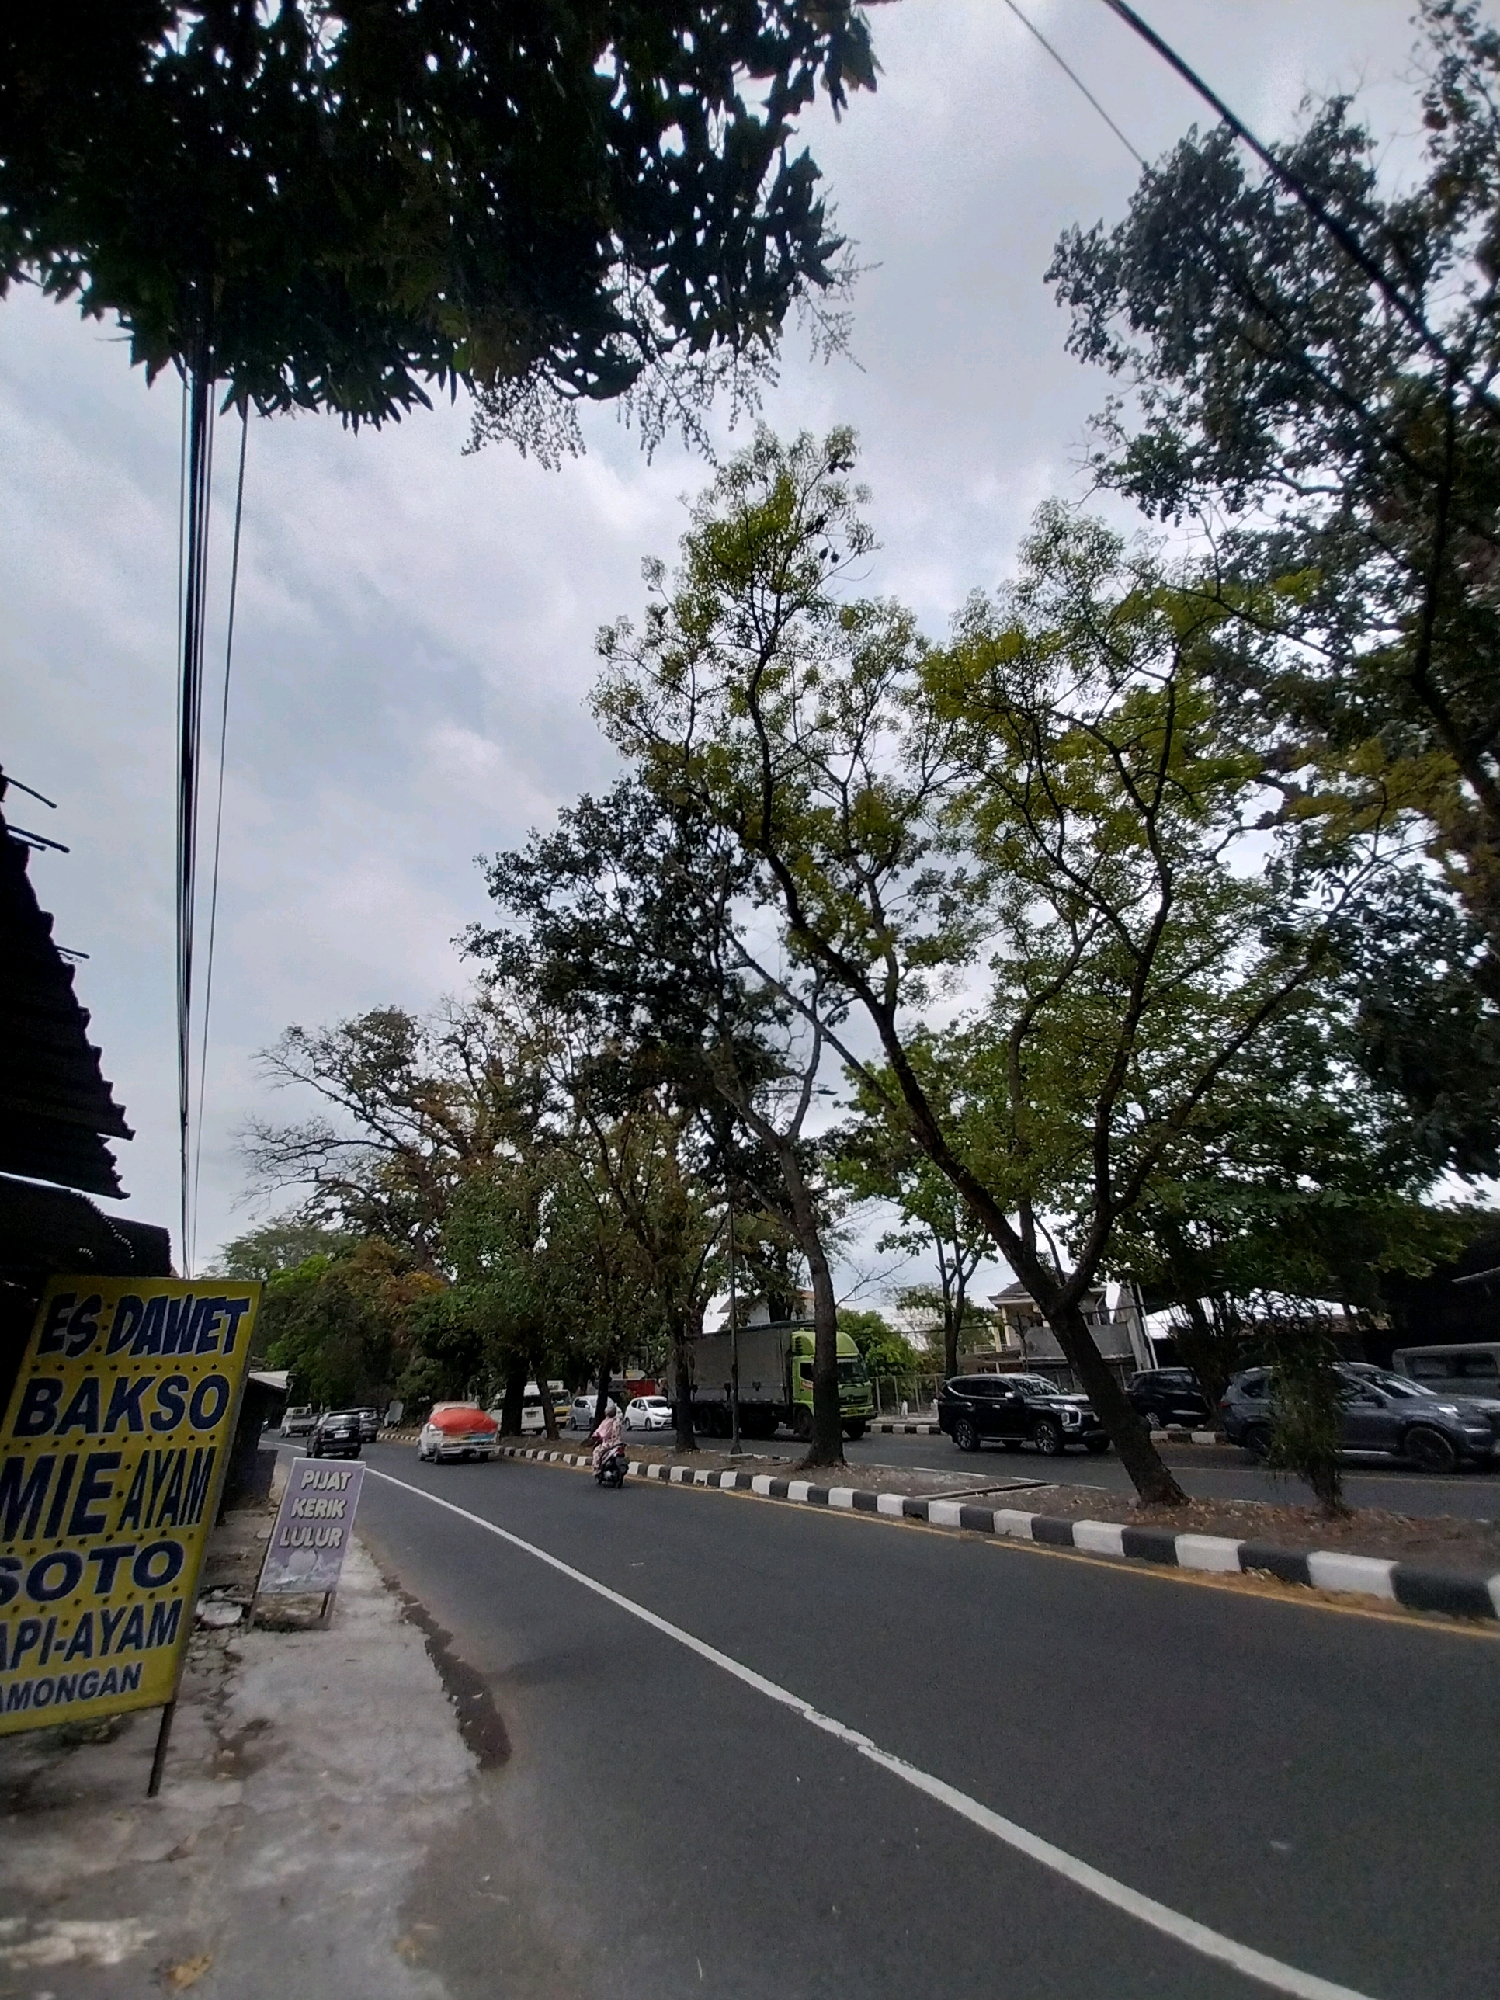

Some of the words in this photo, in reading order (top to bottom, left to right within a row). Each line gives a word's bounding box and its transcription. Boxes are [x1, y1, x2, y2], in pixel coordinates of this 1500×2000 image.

[36, 1292, 102, 1357] ES
[105, 1294, 251, 1356] DAWET
[12, 1374, 231, 1437] BAKSO
[0, 1452, 122, 1542] MIE
[116, 1446, 216, 1532] AYAM
[301, 1469, 352, 1491] PIJAT
[291, 1498, 347, 1519] KERIK
[279, 1526, 344, 1548] LULUR
[0, 1662, 143, 1713] MONGAN
